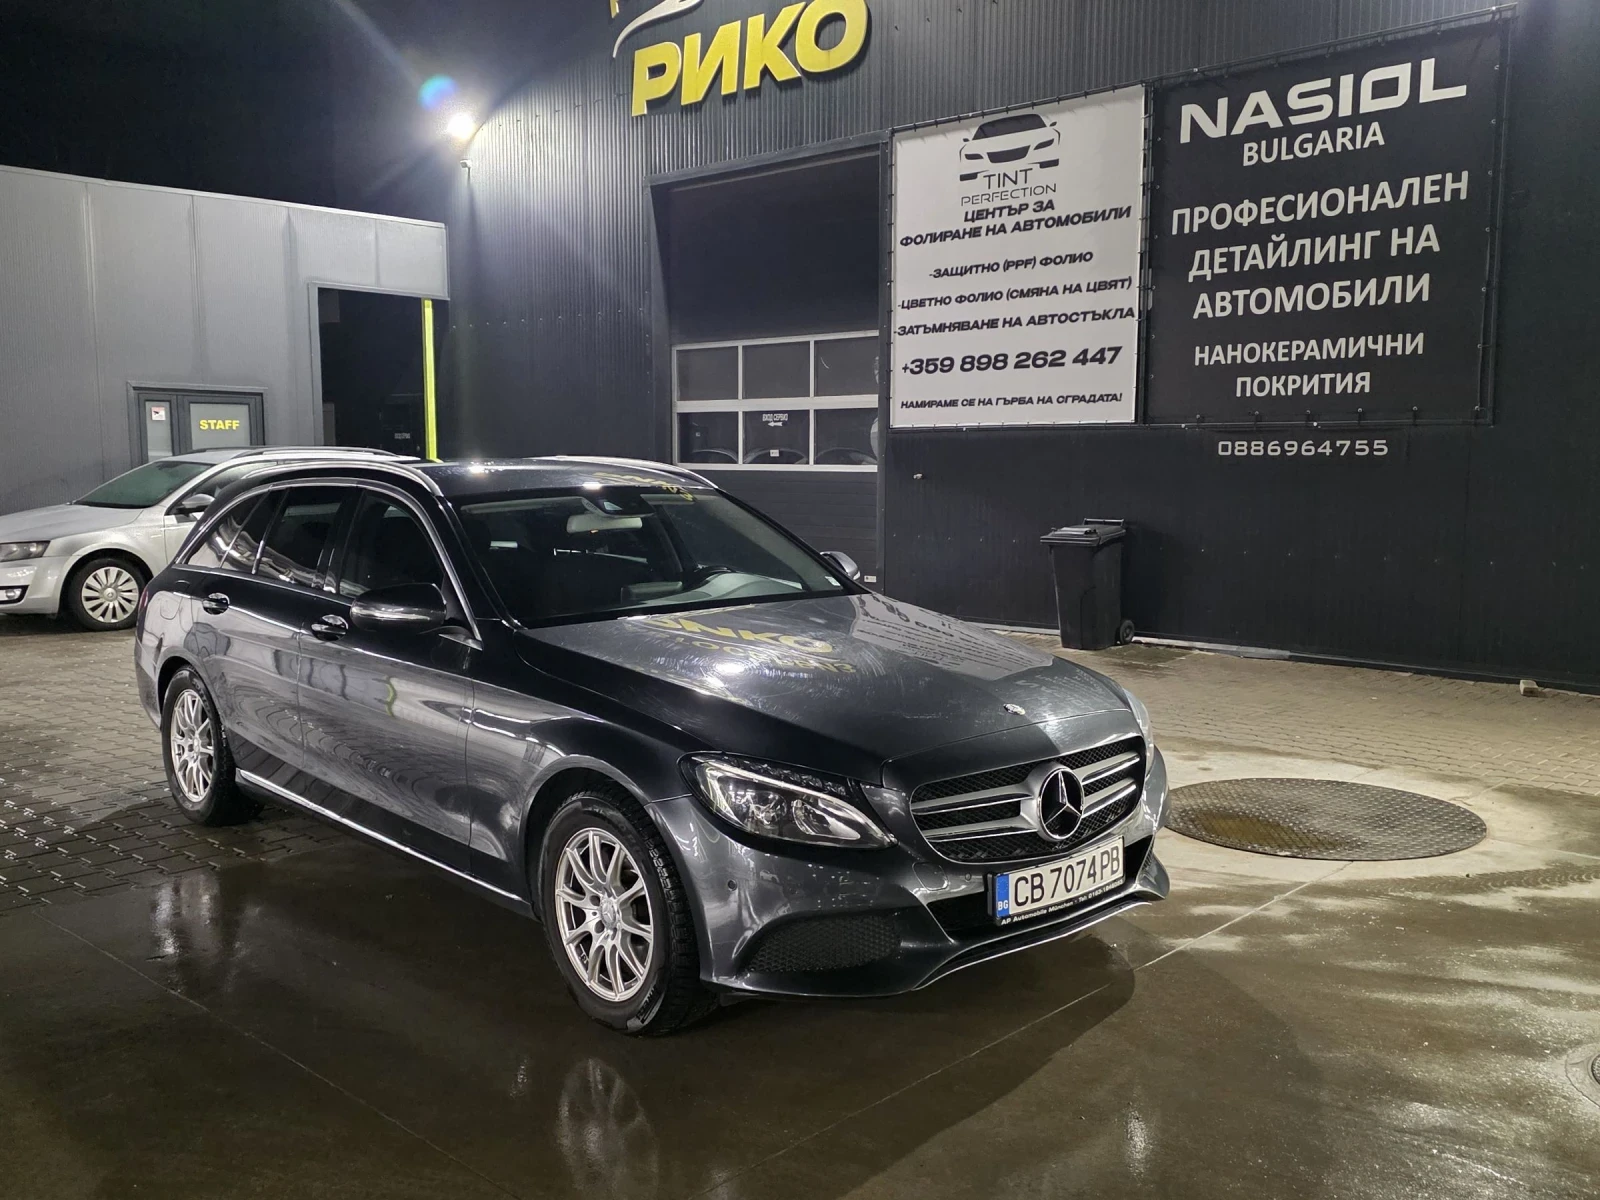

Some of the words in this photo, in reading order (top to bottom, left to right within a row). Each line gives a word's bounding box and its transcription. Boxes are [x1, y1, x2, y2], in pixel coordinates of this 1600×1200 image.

[631, 0, 868, 117] РИКО
[1180, 57, 1467, 144] NASIOL
[1243, 121, 1385, 167] BULGARIA
[983, 168, 1033, 190] TINT
[961, 183, 1057, 207] PERFECTION
[1171, 170, 1469, 235] ПРОФЕСИОНАЛЕН
[899, 225, 983, 247] ФОЛИРАНЕ
[985, 223, 1008, 237] НА
[1010, 205, 1132, 234] АВТОМОБИЛИ
[964, 202, 1030, 223] ЦЕНТЪР
[1032, 199, 1055, 213] ЗА
[929, 261, 1000, 279] -ЗАЩИТНО
[1002, 255, 1037, 272] (PPF)
[1039, 251, 1094, 267] ФОЛИО
[1189, 230, 1381, 283] ДЕТАЙЛИНГ
[1390, 223, 1440, 257] НА
[897, 296, 952, 311] -ЦВЕТНО
[954, 290, 1004, 305] ФОЛИО
[1005, 285, 1060, 302] (СМЯНА
[1062, 281, 1083, 295] НА
[1085, 276, 1133, 294] ЦВЯТ)
[1193, 273, 1431, 319] АВТОМОБИЛИ
[893, 318, 1000, 337] -ЗАТЪМНЯВАНЕ
[1002, 316, 1023, 329] НА
[1026, 307, 1136, 327] АВТОСТЪКЛА
[901, 356, 955, 375] +359
[959, 353, 1009, 373] 898
[1013, 349, 1067, 370] 262
[1072, 345, 1124, 366] 447
[1194, 332, 1425, 367] НАНОКЕРАМИЧНИ
[1236, 371, 1371, 398] ПОКРИТИЯ
[900, 398, 959, 409] НАМИРАМЕ
[961, 398, 976, 408] СЕ
[977, 397, 994, 407] НА
[995, 395, 1034, 406] ГЪРБА
[1036, 395, 1054, 405] НА
[1056, 392, 1123, 405] СГРАДАТА!
[199, 419, 240, 431] STAFF
[1217, 439, 1389, 457] 0886964755
[1014, 872, 1045, 907] CB
[1050, 855, 1097, 899] 7074
[1100, 846, 1120, 881] PB
[997, 899, 1009, 911] BG
[1001, 917, 1011, 926] AP
[1012, 908, 1048, 922] Automobile
[1048, 901, 1074, 913] München
